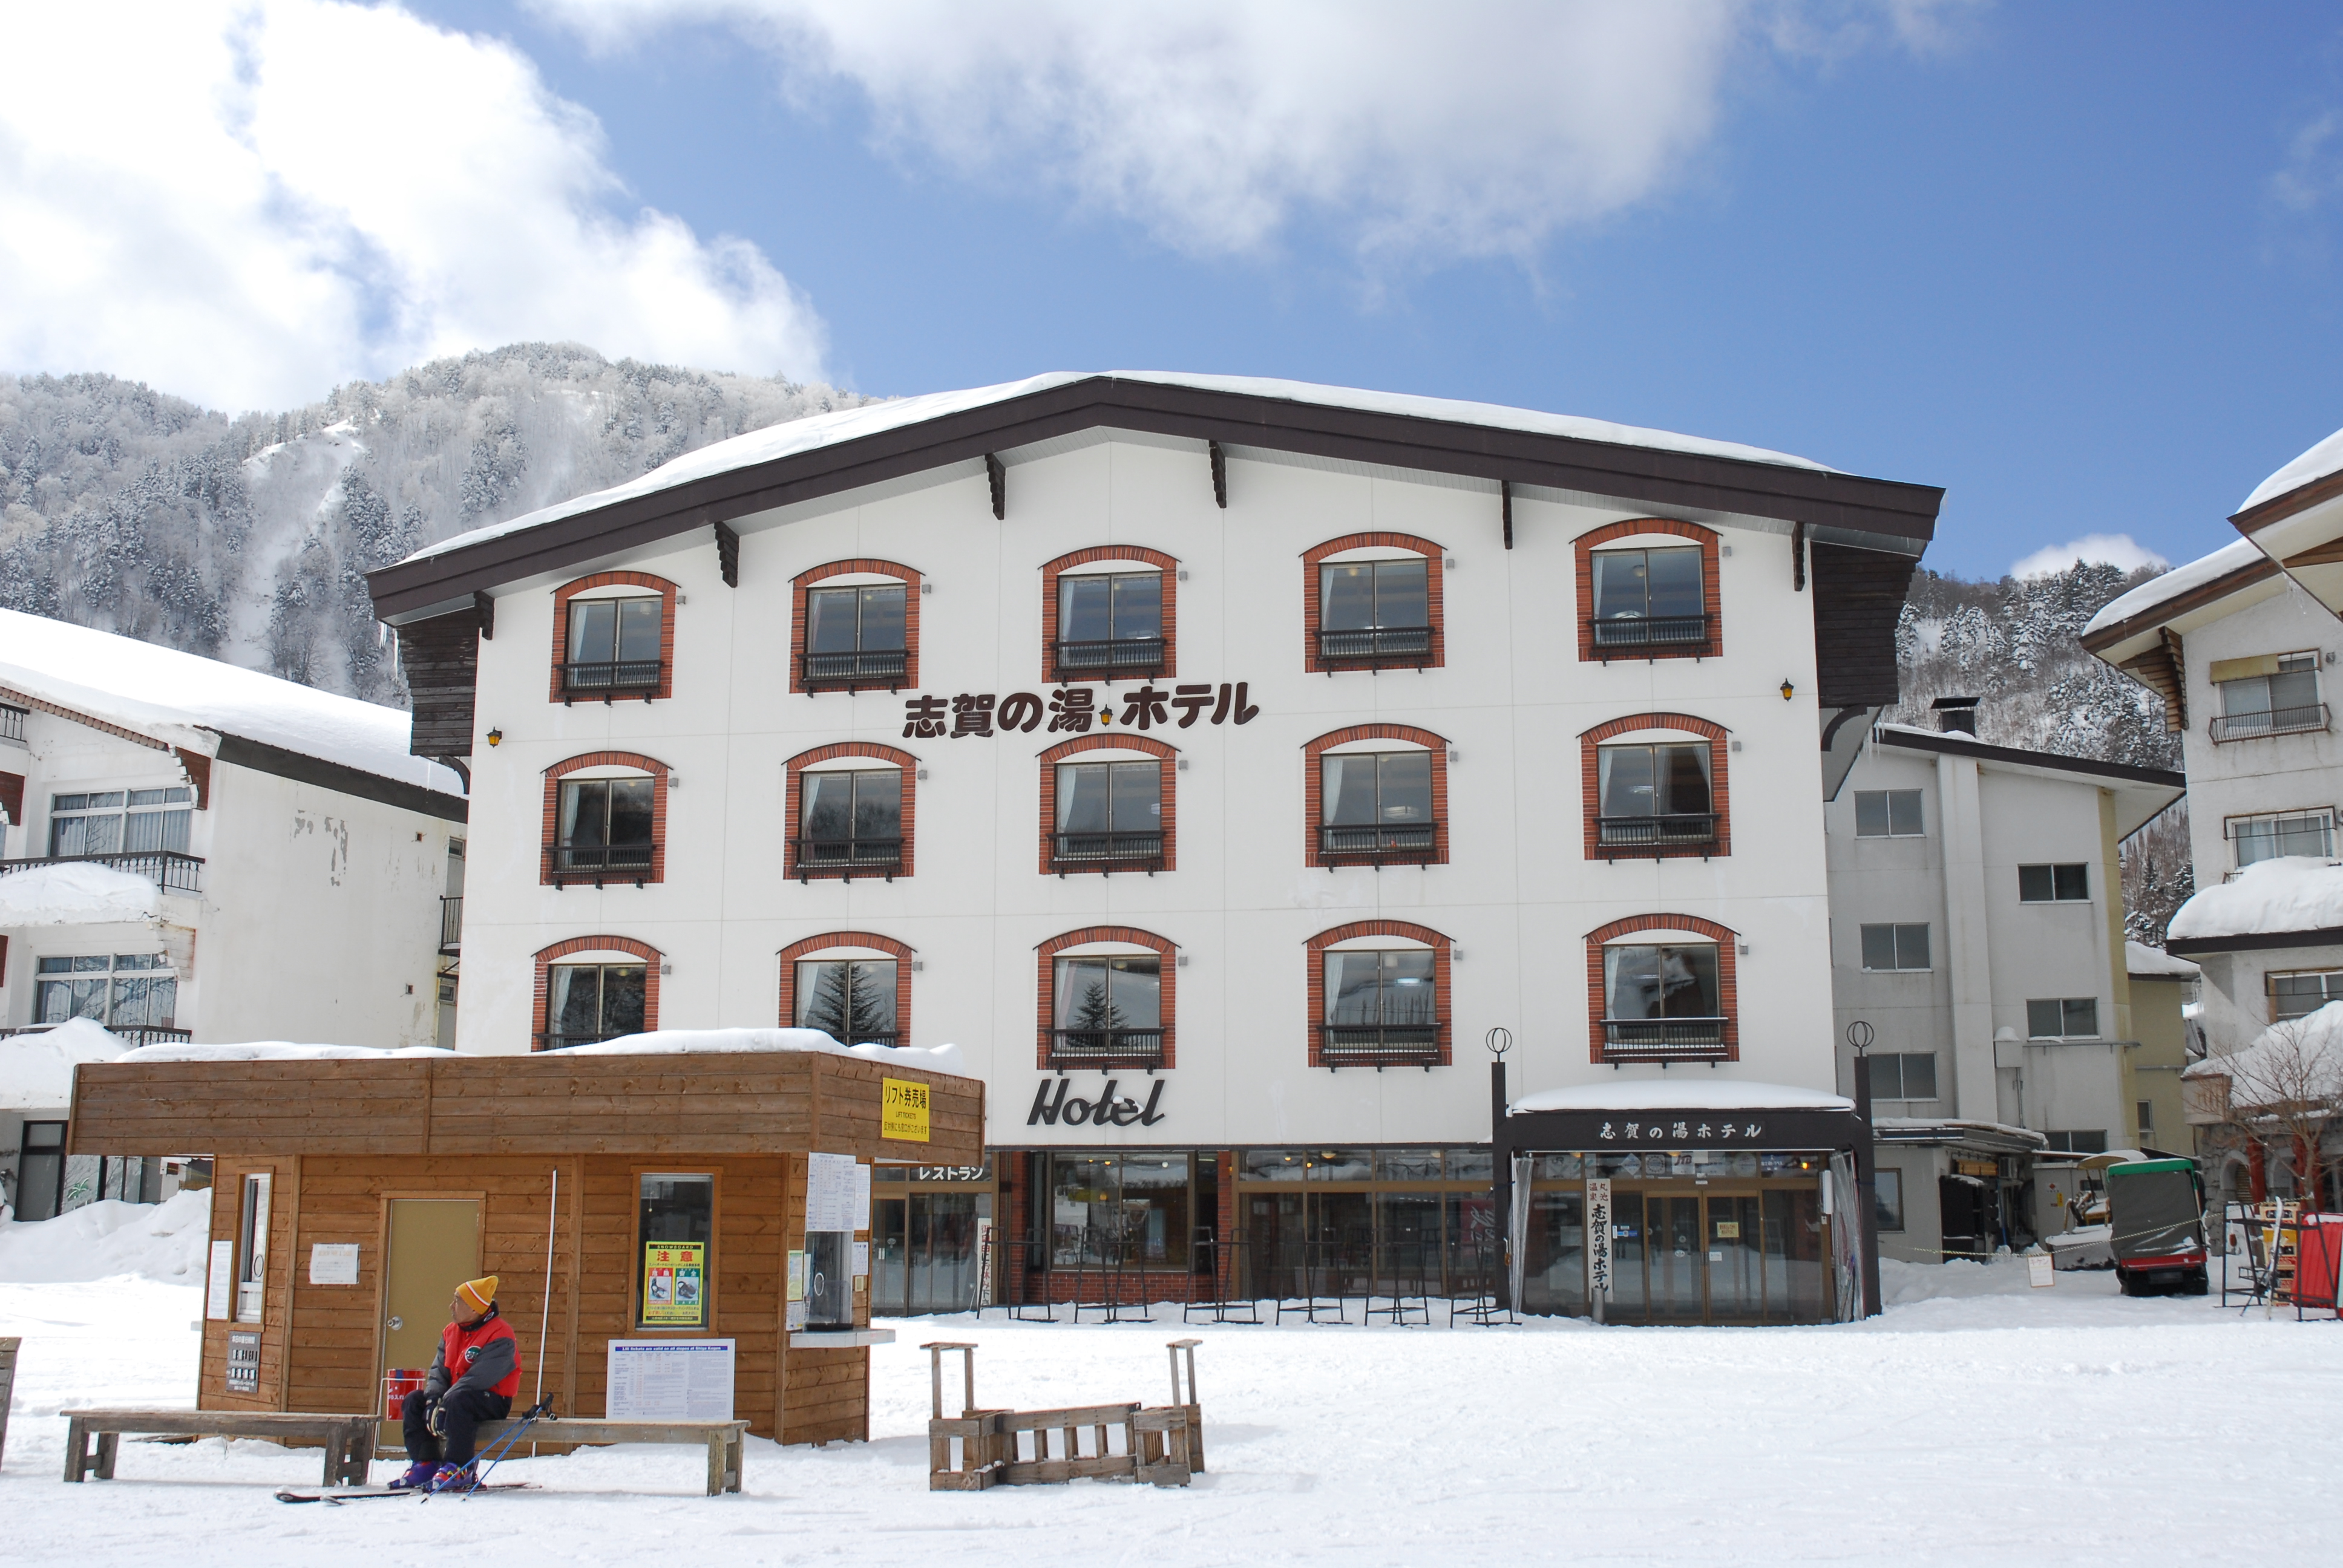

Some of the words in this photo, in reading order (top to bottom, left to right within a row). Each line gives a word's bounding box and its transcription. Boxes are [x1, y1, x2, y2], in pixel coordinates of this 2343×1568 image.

[902, 682, 1259, 739] 志賀の湯ホテル
[885, 1085, 926, 1109] リフト券売場
[1027, 1079, 1167, 1127] Hotel
[1601, 1122, 1763, 1140] 志賀の湯ホテル
[1674, 1155, 1693, 1166] JTB
[919, 1166, 984, 1181] レストラン
[1590, 1203, 1609, 1293] 志賀の湯ホテル
